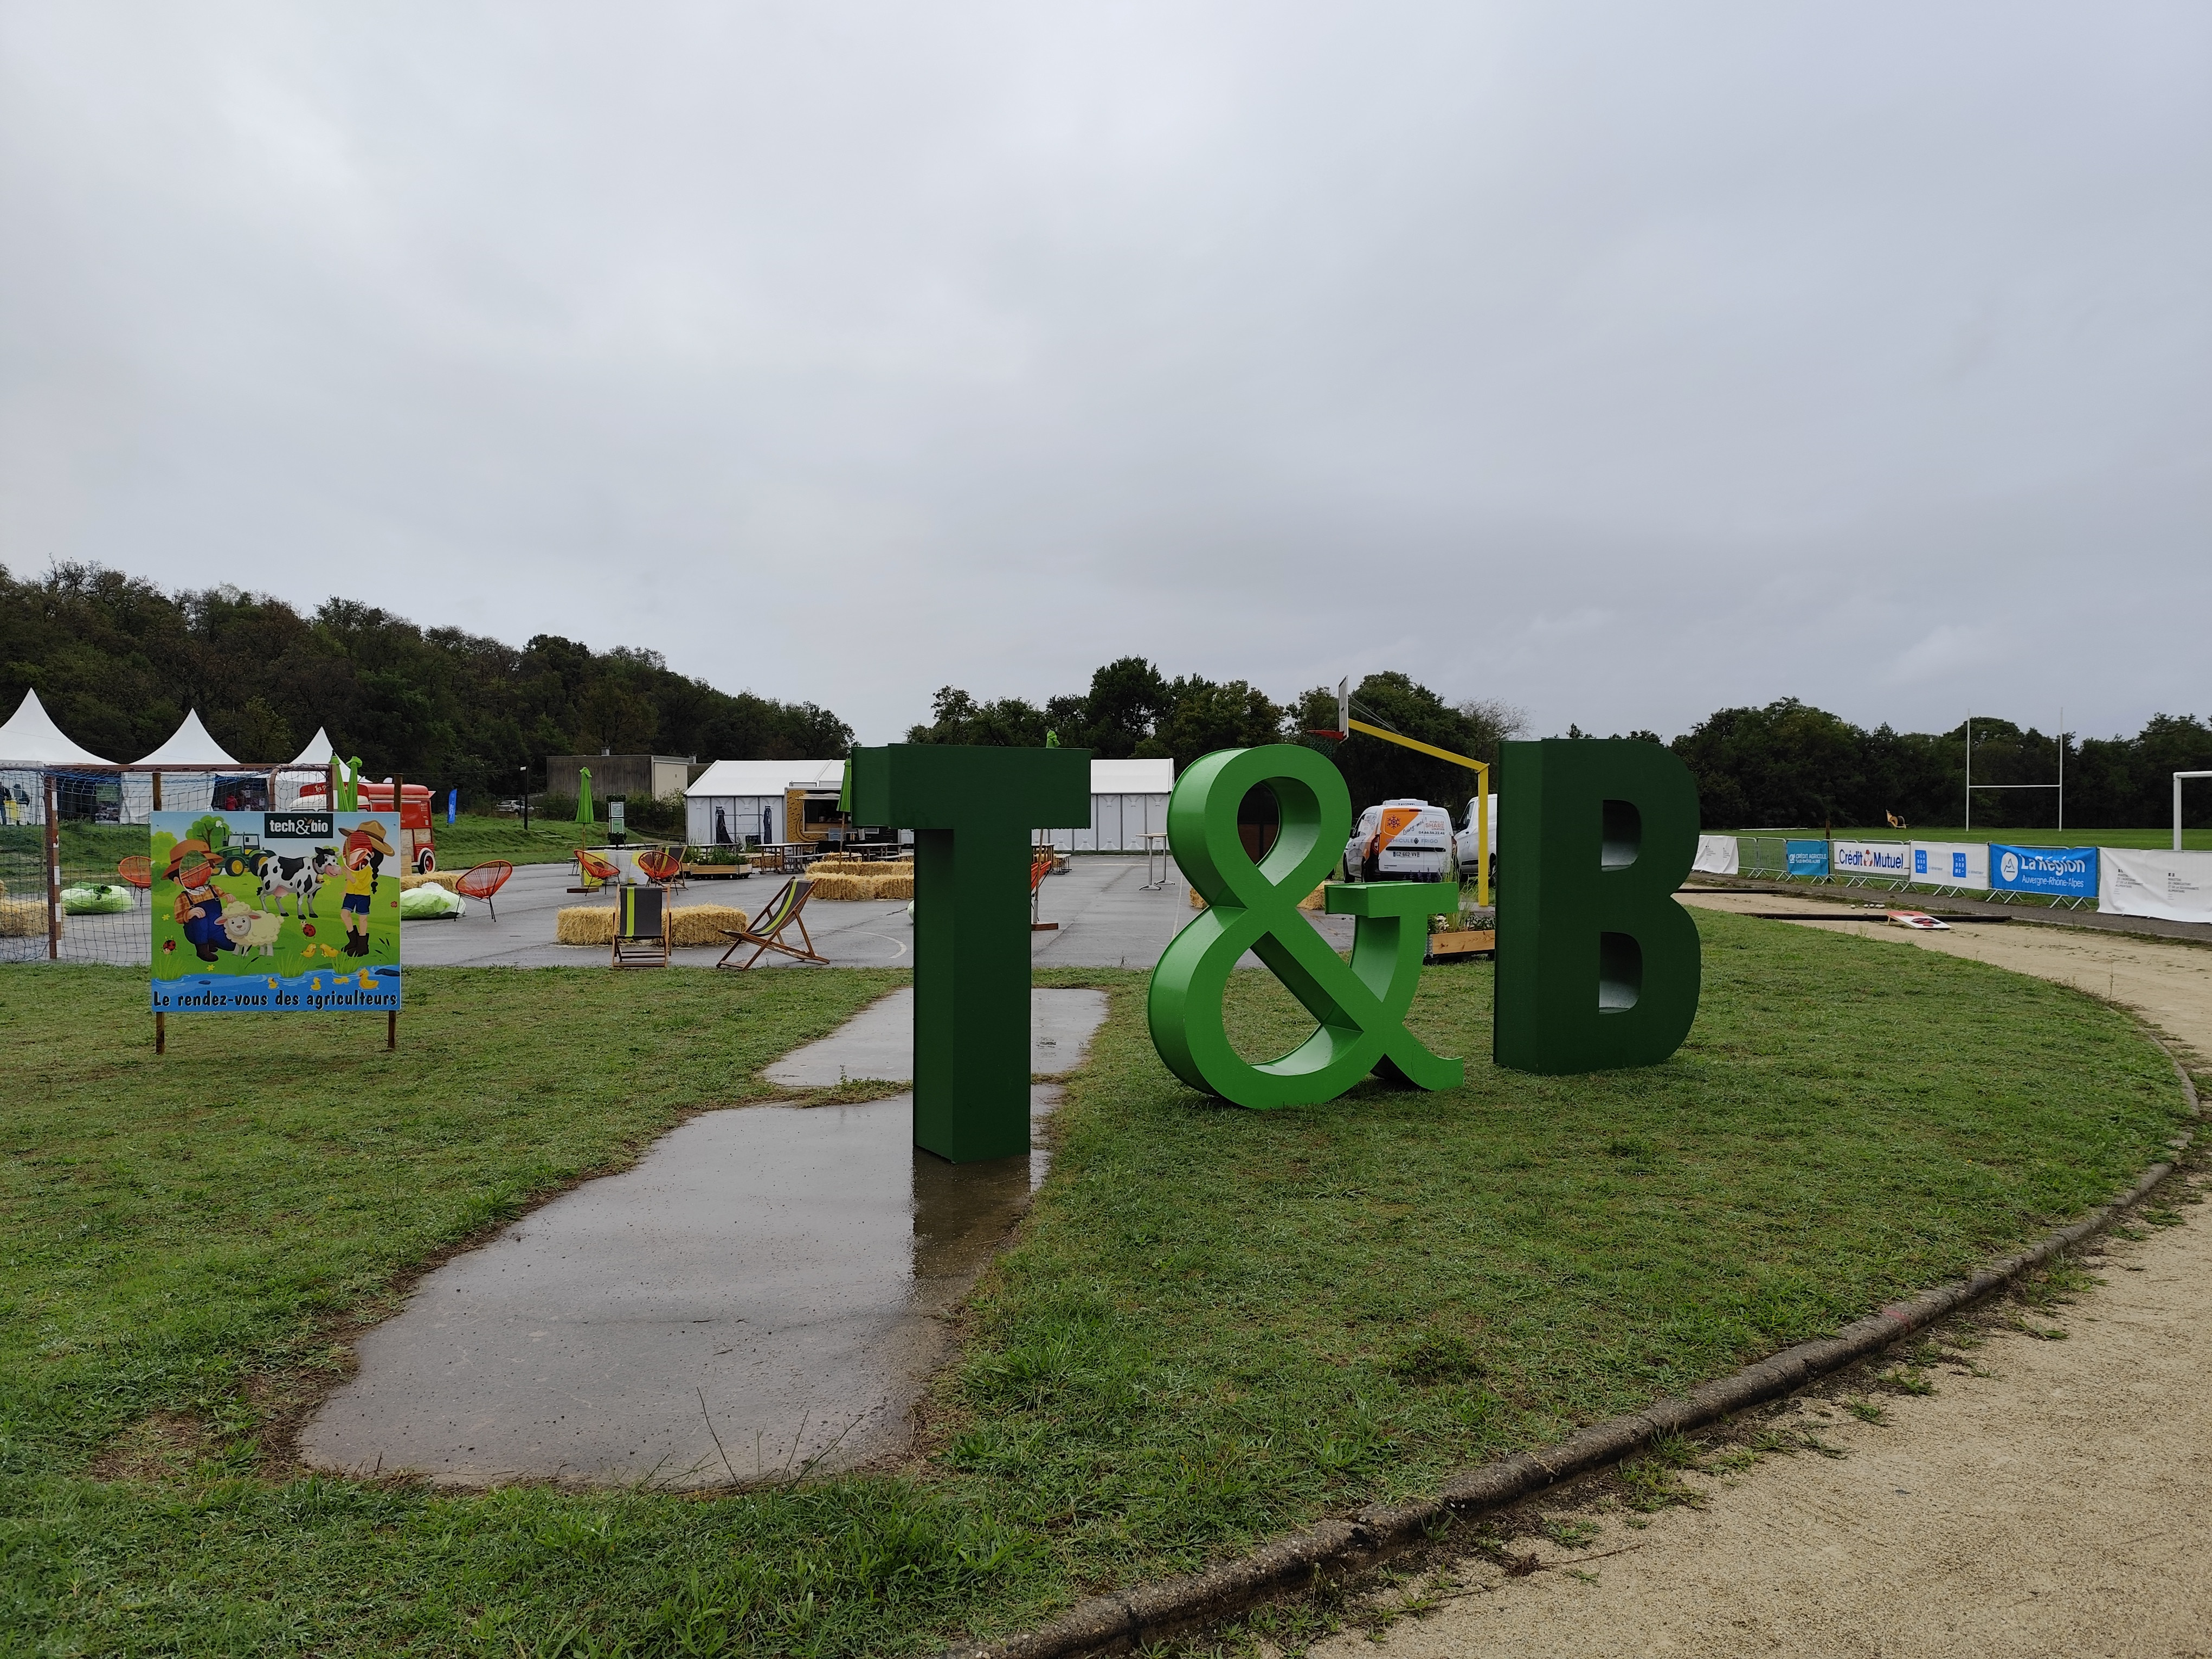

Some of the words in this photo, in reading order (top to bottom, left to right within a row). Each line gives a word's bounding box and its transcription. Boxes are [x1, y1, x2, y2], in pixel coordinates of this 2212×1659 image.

[269, 819, 329, 835] tech&bio
[1839, 848, 1863, 866] Crédit
[1873, 852, 1904, 869] Mutuel
[2018, 853, 2036, 870] La
[2035, 856, 2086, 876] Région
[2022, 874, 2084, 889] Auvergne-Rhône-Alpes
[154, 991, 170, 1006] Le
[178, 991, 268, 1006] rendez-vous
[275, 990, 299, 1006] des
[306, 990, 397, 1010] agriculteurs
